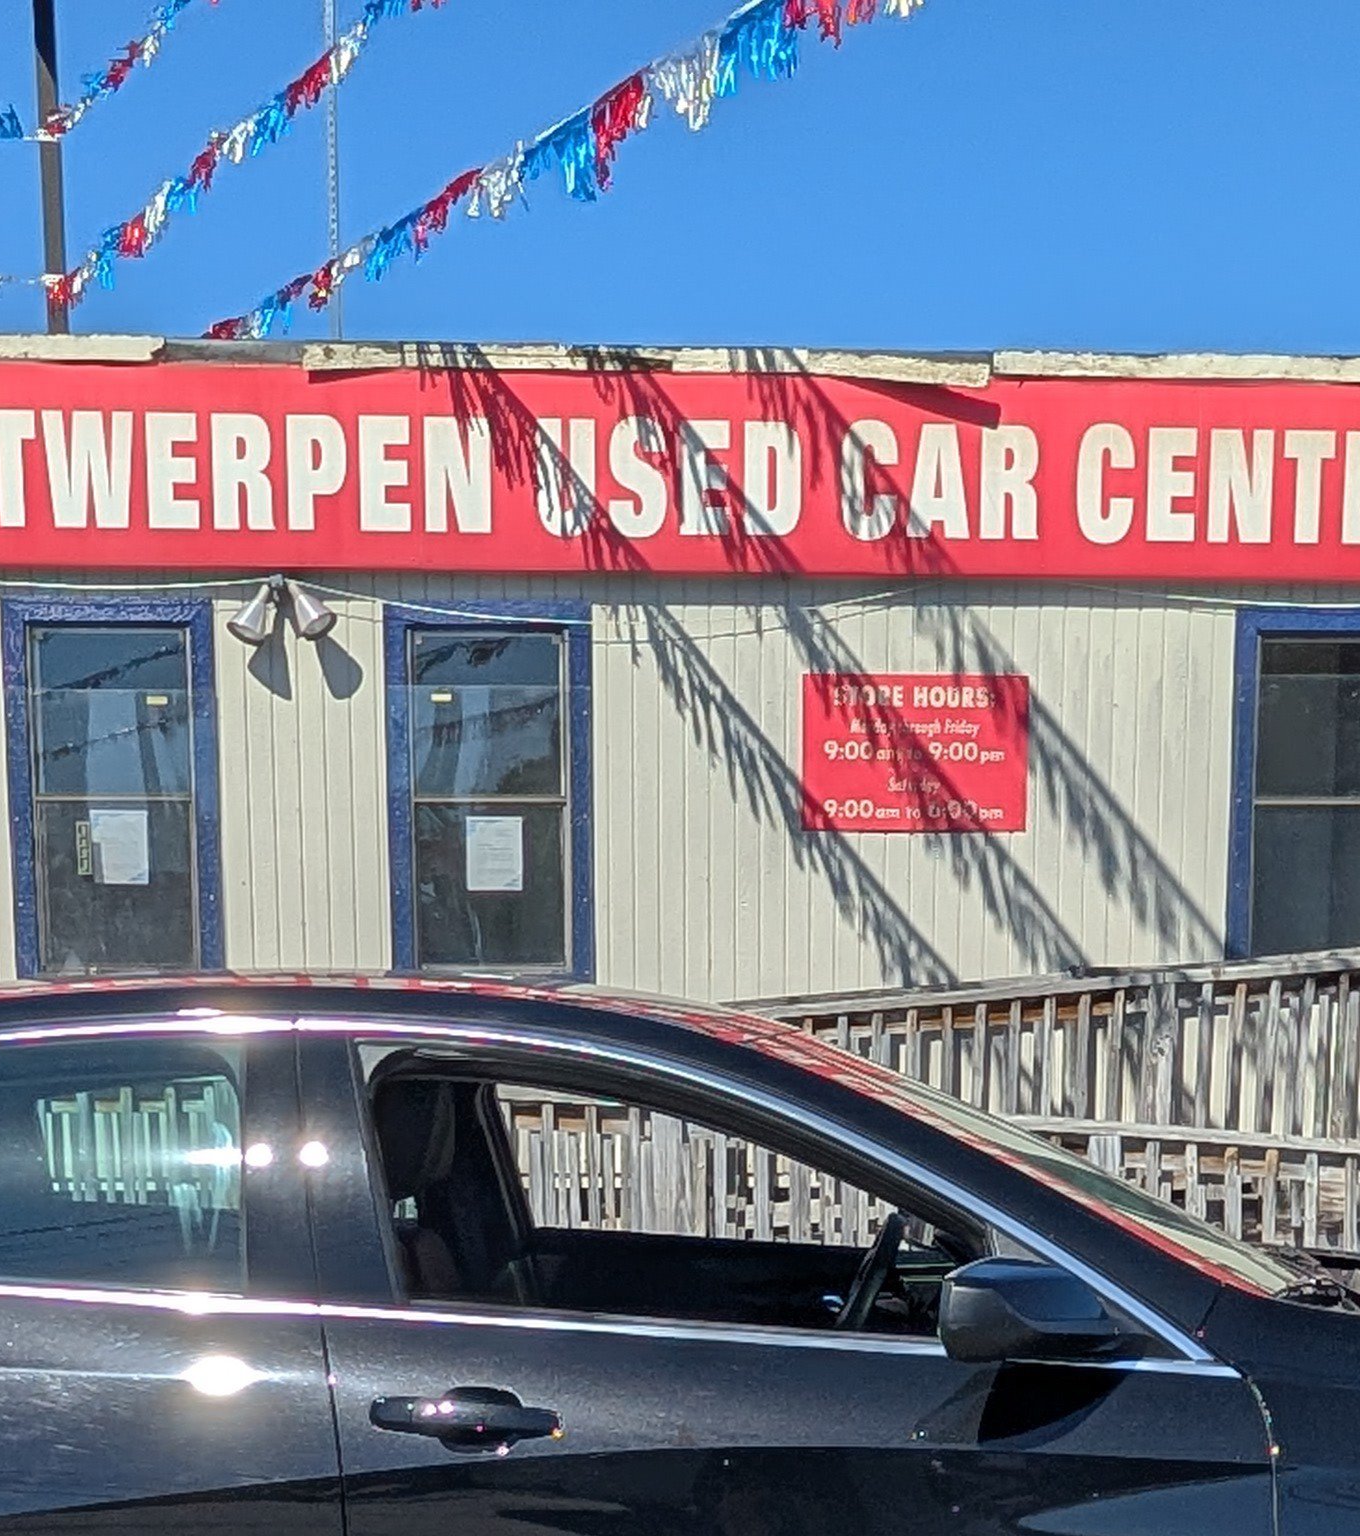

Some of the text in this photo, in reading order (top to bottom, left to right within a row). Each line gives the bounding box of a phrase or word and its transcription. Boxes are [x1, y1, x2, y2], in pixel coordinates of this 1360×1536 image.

[535, 414, 803, 539] USED
[841, 418, 1040, 542] CAR
[943, 718, 982, 738] Friday
[887, 776, 941, 795] Satuday
